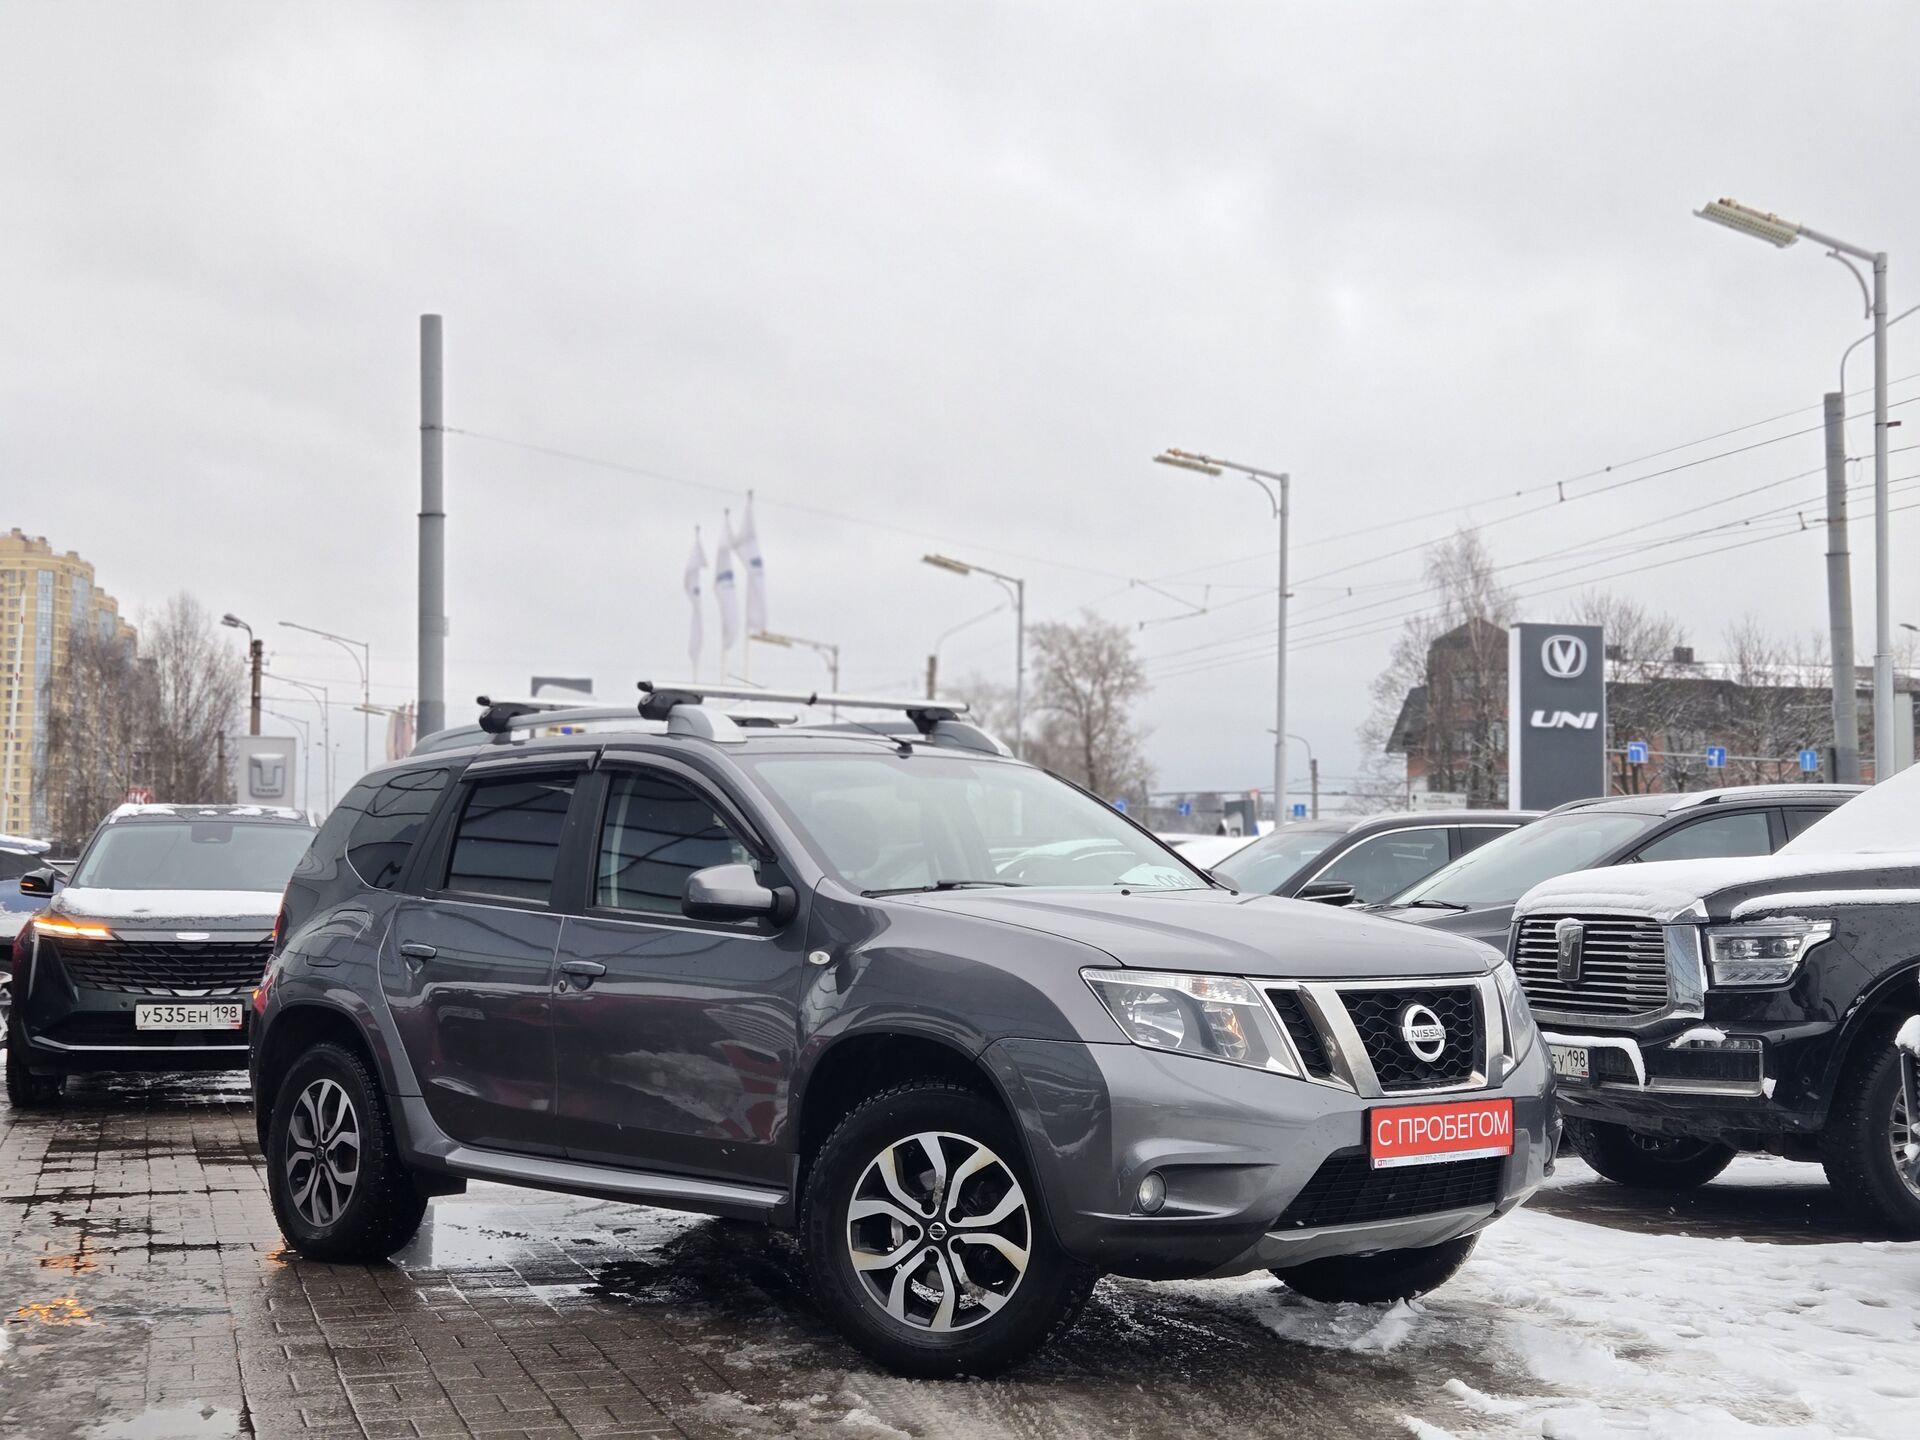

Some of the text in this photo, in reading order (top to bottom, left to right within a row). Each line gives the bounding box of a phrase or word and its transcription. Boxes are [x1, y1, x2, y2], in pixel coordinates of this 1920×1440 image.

[1530, 710, 1599, 730] UNI
[212, 1006, 238, 1019] 198
[1411, 1028, 1445, 1038] NISSAN
[1567, 1049, 1586, 1068] 198
[1377, 1109, 1510, 1146] С ПРОБЕГОМ
